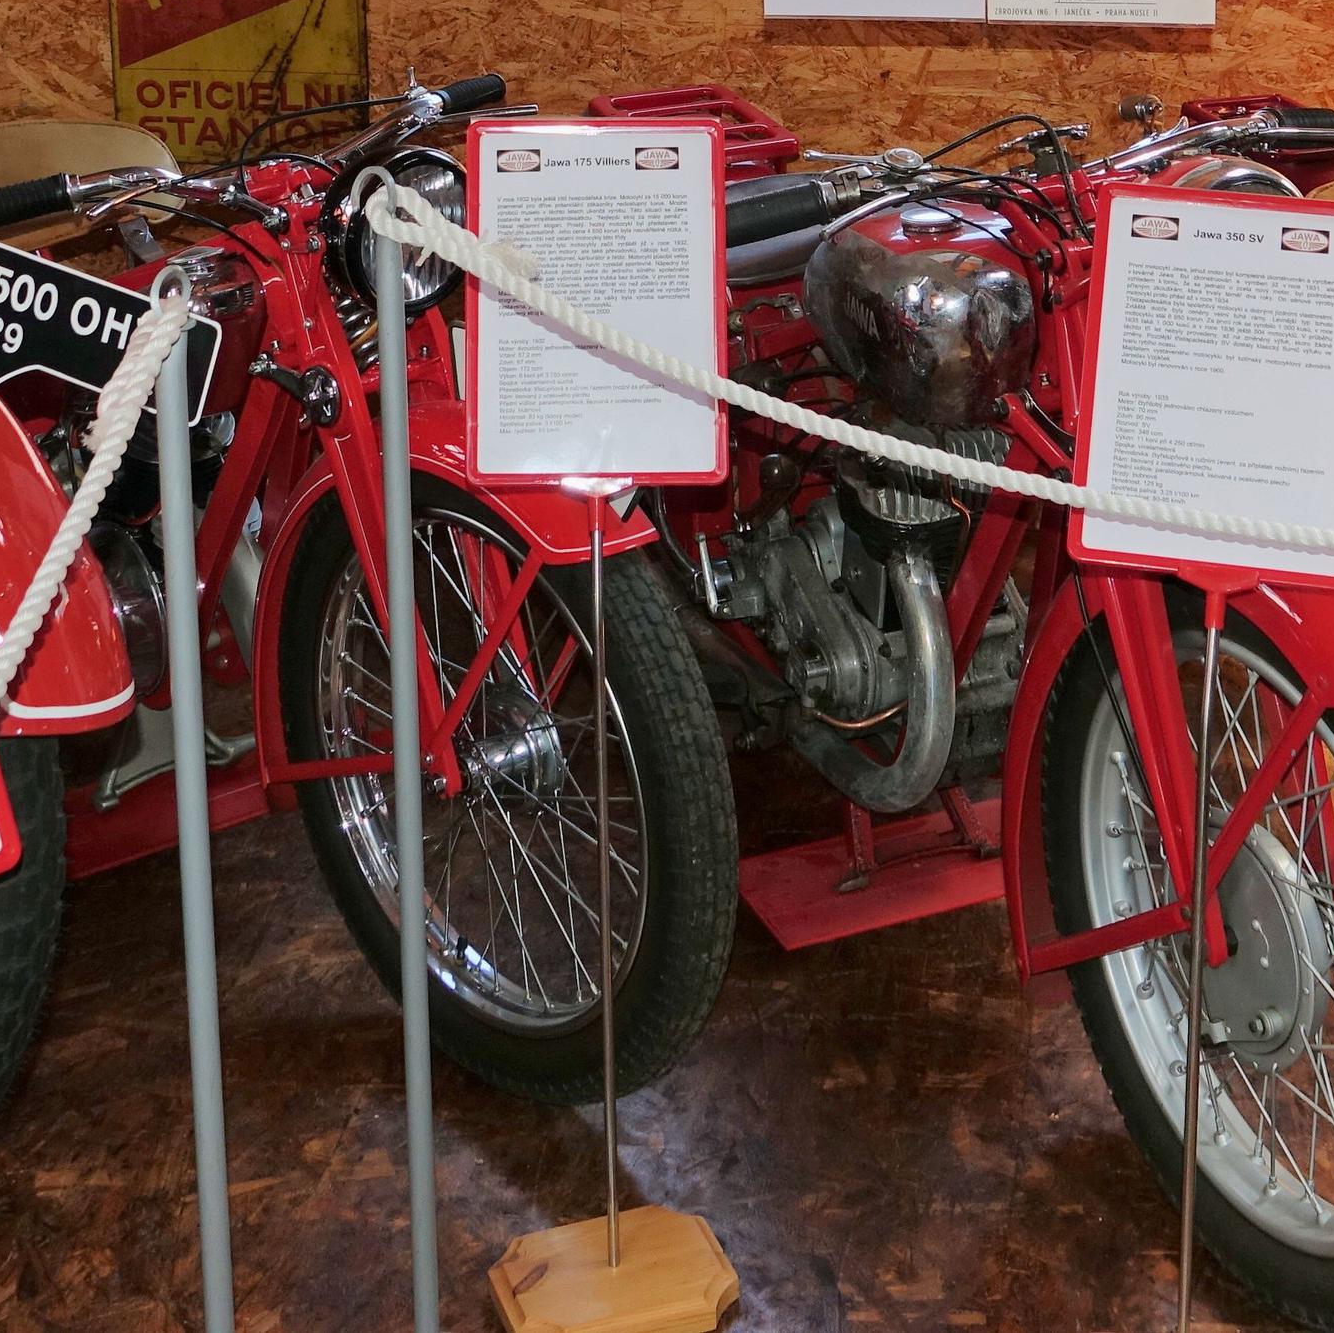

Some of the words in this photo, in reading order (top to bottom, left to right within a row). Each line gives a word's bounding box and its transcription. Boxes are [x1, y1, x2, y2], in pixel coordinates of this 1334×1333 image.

[544, 157, 571, 167] Jawa
[575, 157, 592, 166] 175
[596, 156, 631, 166] Villiers
[1193, 229, 1222, 240] Jawa
[1226, 232, 1245, 242] 350
[1248, 233, 1265, 244] SV
[70, 297, 133, 351] OH
